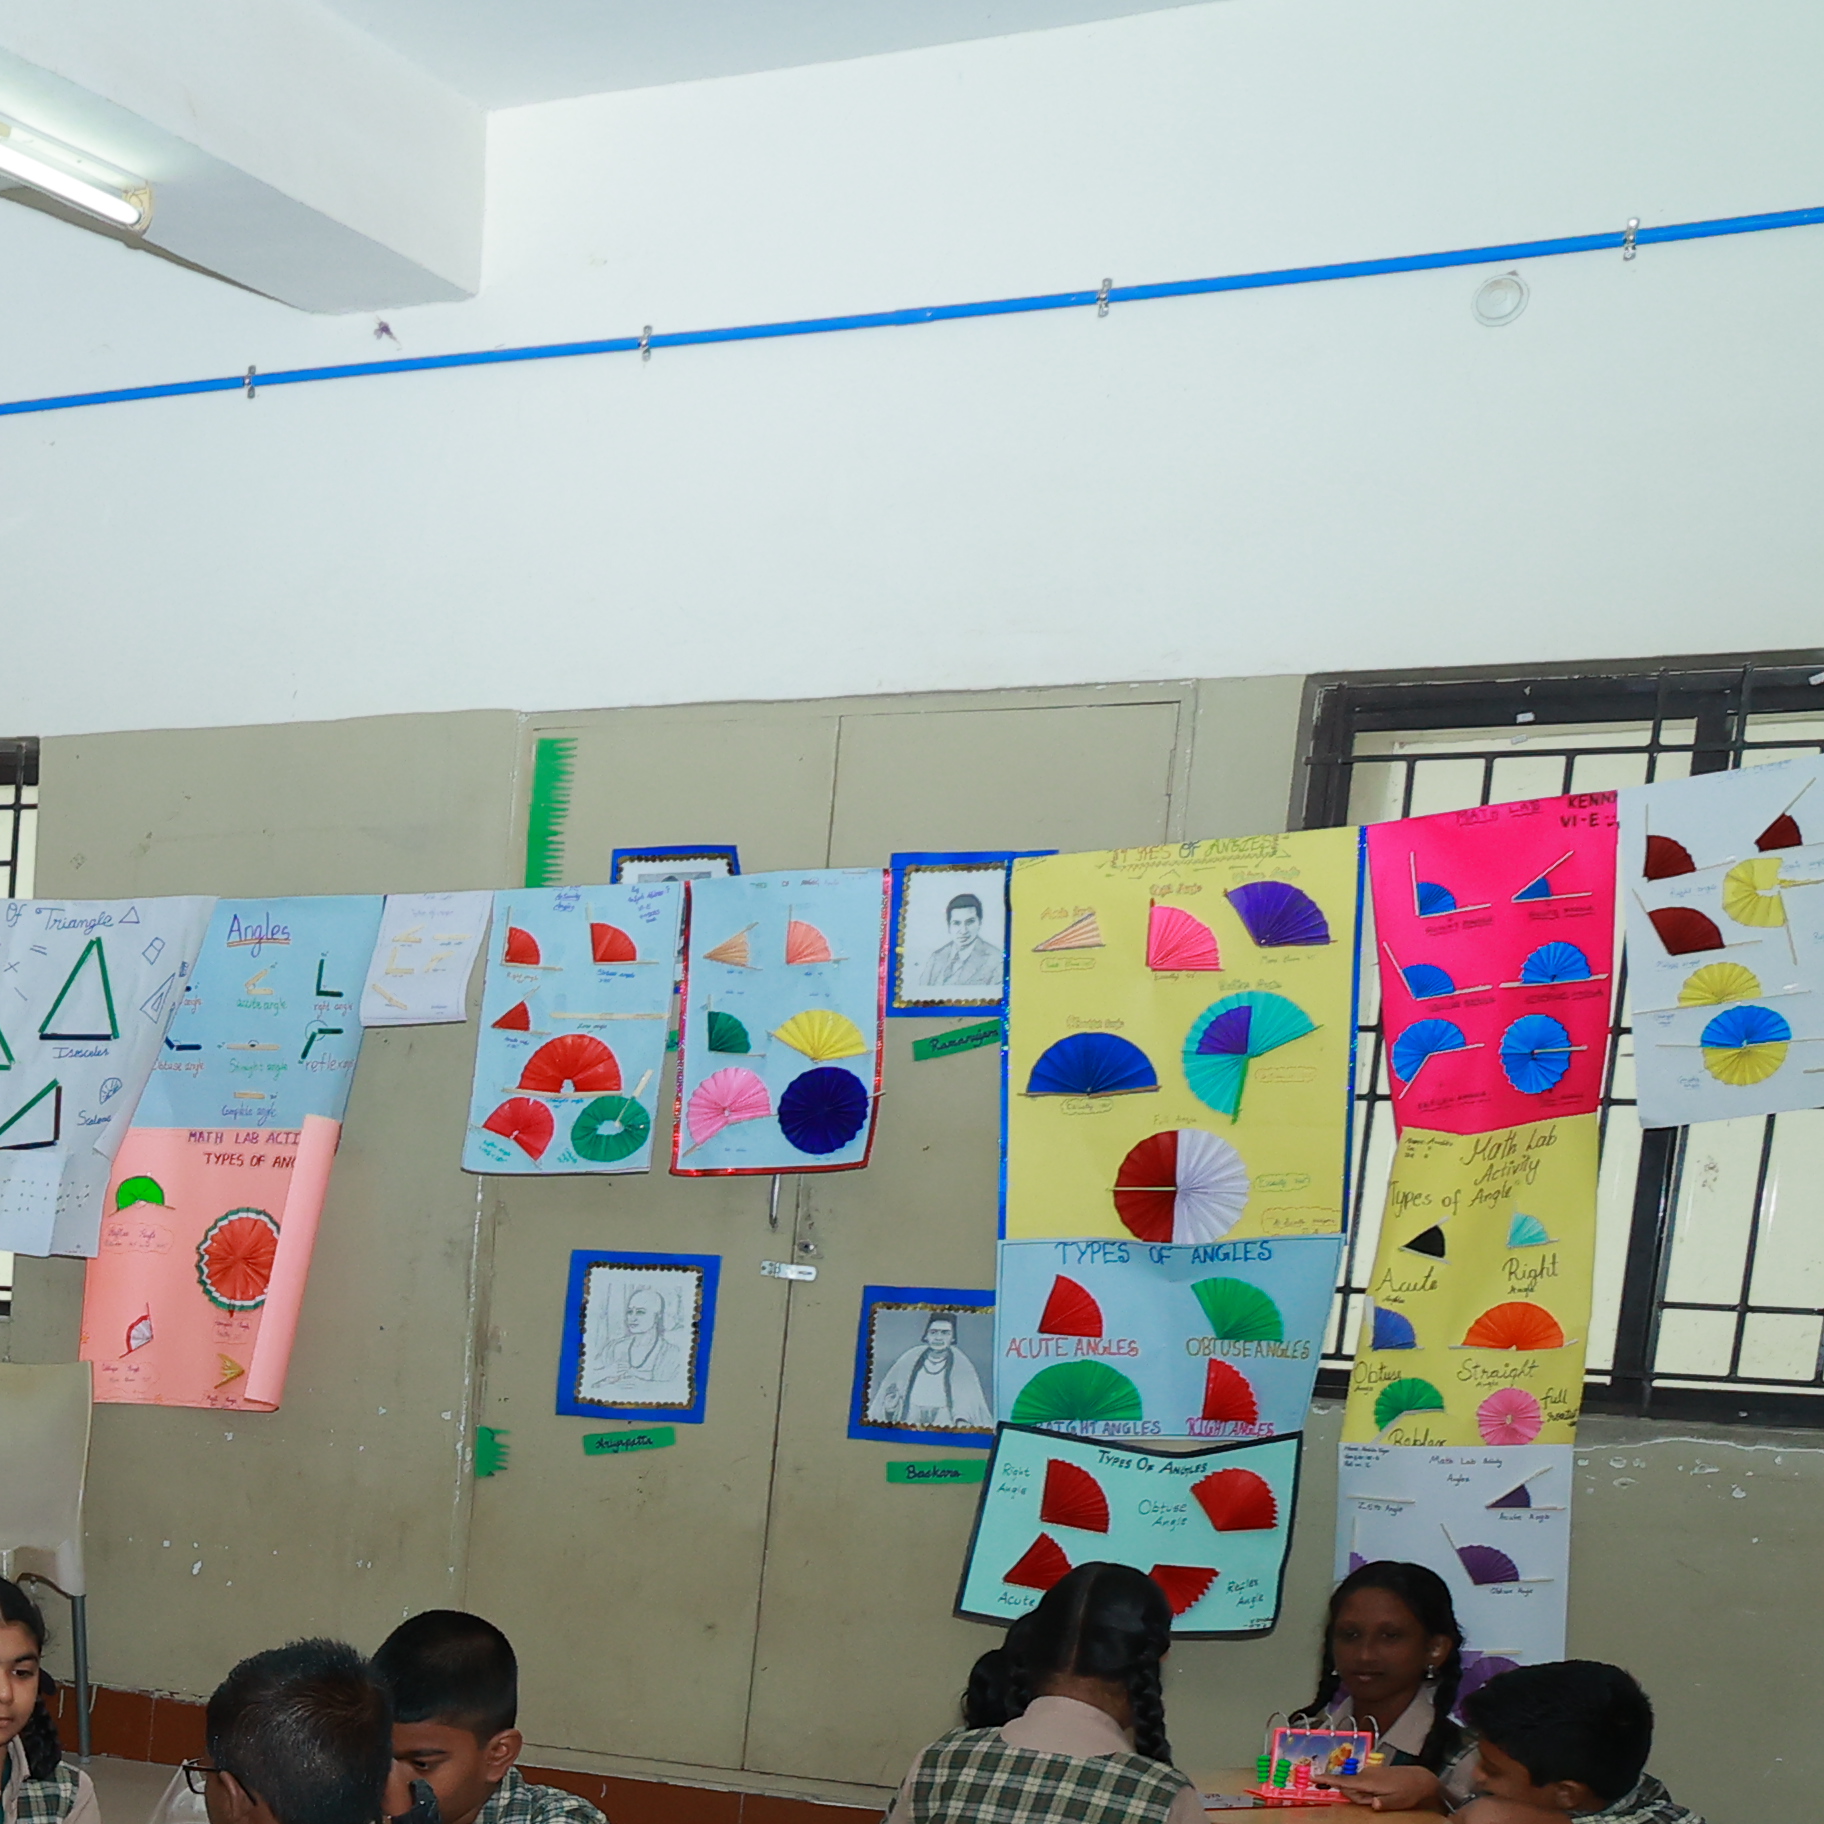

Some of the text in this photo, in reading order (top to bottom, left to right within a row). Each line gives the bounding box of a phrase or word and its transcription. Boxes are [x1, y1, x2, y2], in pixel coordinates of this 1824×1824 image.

[227, 912, 292, 958] Angles
[188, 1131, 224, 1144] MATH
[1460, 1129, 1518, 1166] Math
[204, 1153, 244, 1168] TYPES
[1054, 1241, 1131, 1264] TYPES
[1191, 1241, 1273, 1263] ANGLES
[1374, 1265, 1439, 1294] Acute
[1501, 1253, 1560, 1286] Right
